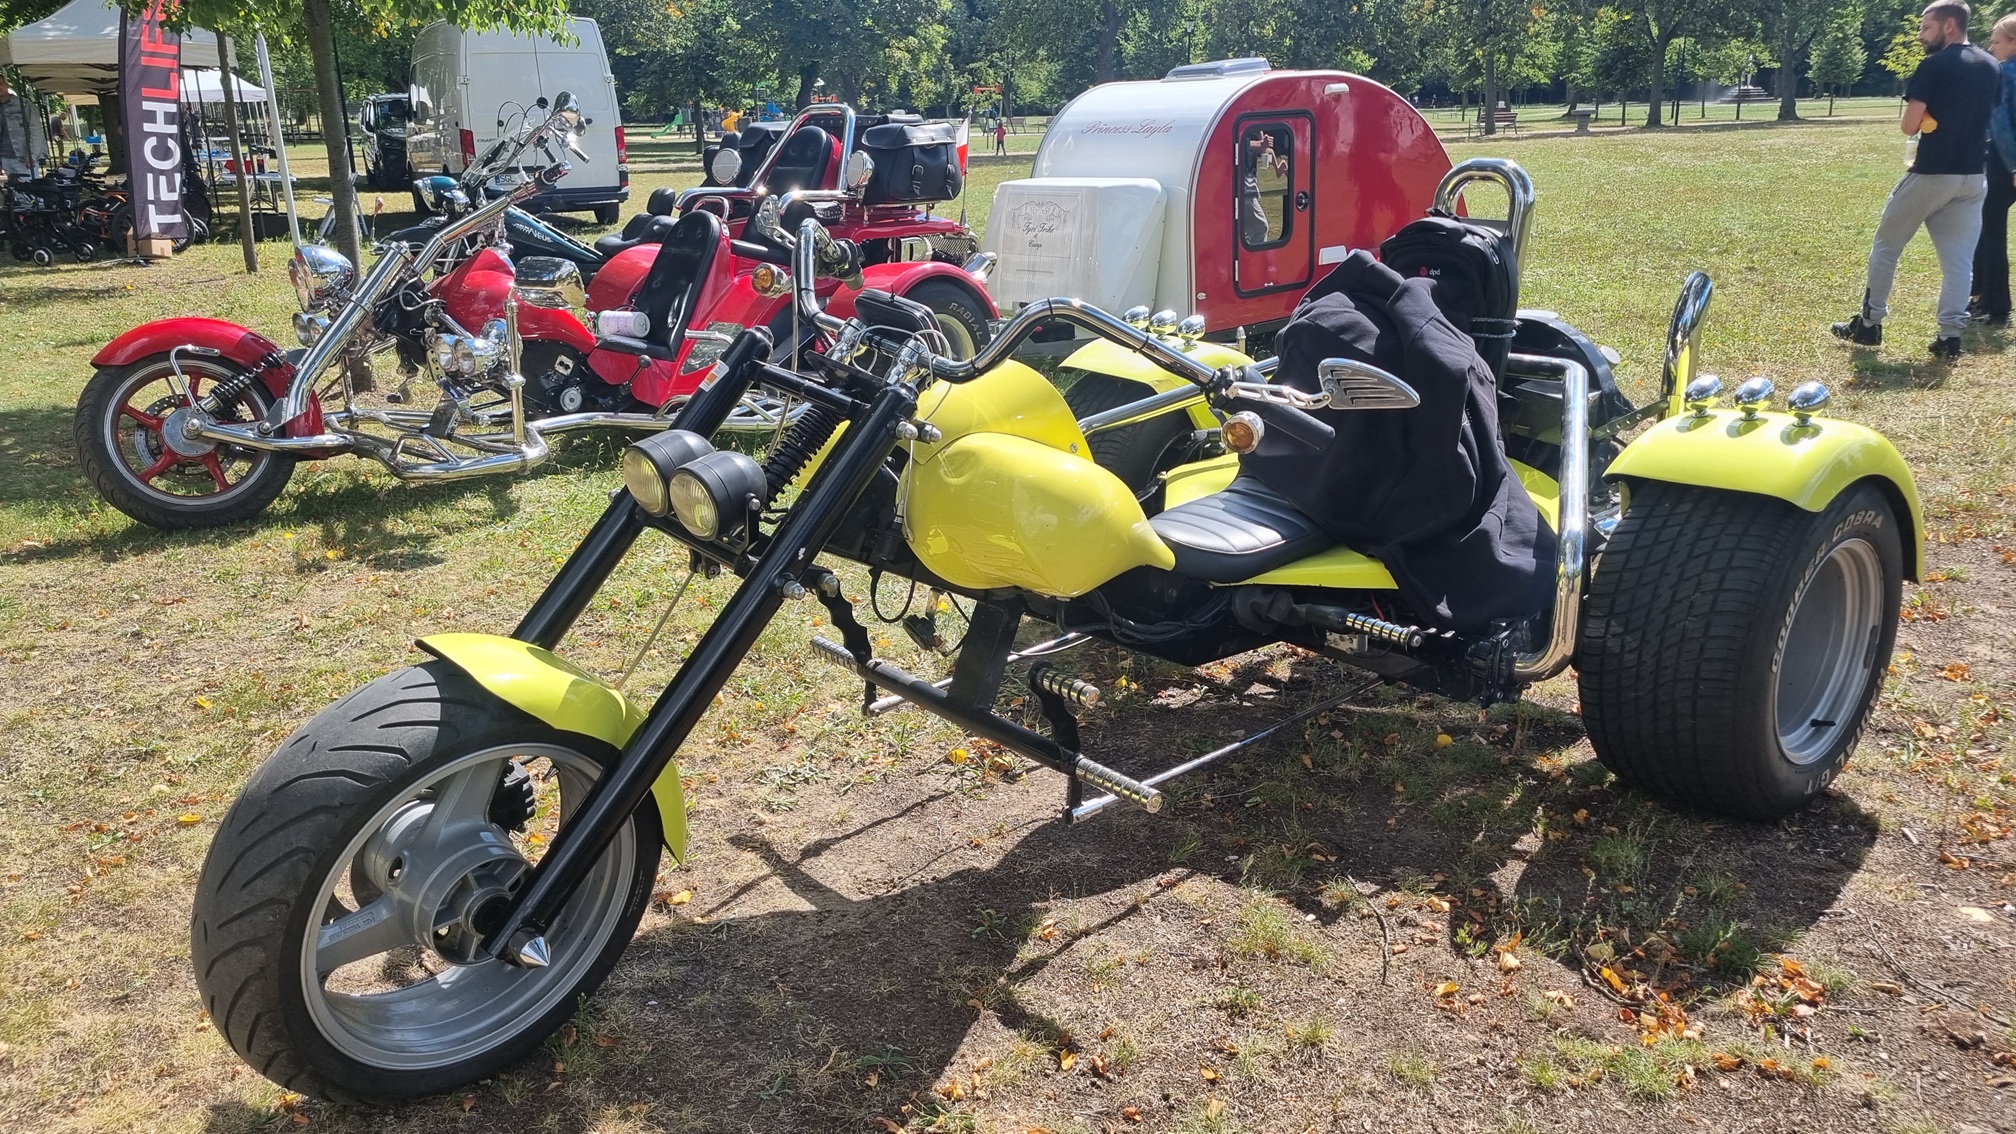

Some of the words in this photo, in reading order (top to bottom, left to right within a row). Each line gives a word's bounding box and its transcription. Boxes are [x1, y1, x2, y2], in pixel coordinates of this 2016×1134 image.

[1081, 120, 1132, 135] Princess
[1131, 118, 1176, 139] Layla
[1429, 267, 1441, 277] dpd
[948, 302, 983, 340] RADIAL
[1771, 541, 1827, 674] COOPER
[1831, 510, 1884, 543] COBRA
